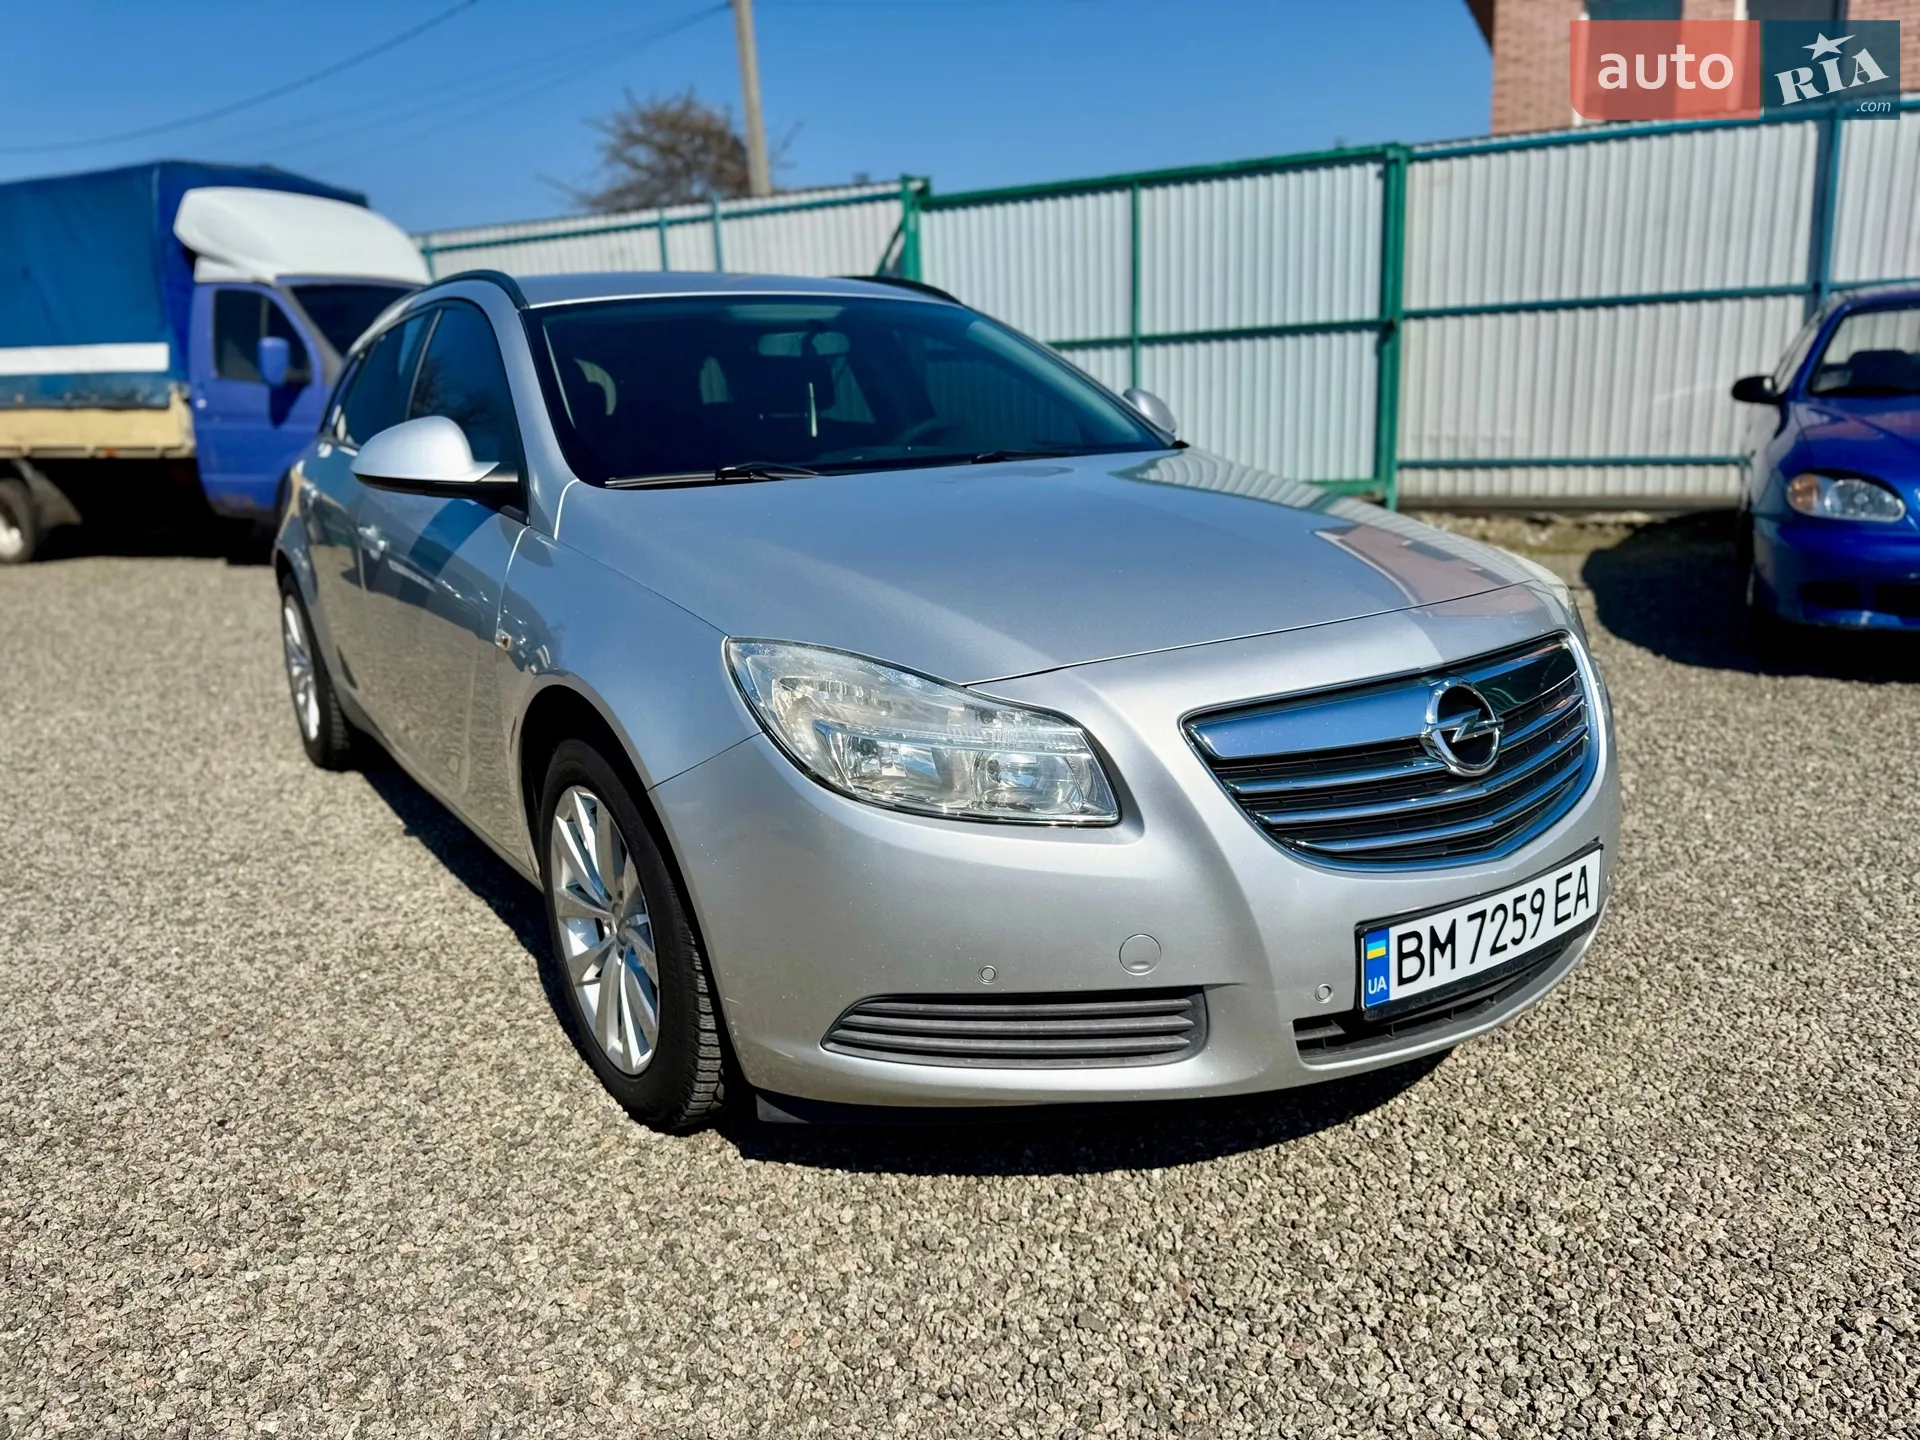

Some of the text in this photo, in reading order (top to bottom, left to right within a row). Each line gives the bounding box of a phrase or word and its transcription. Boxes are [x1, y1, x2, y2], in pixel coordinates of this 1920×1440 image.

[1397, 918, 1457, 987] BM
[1467, 888, 1546, 965] 7259
[1553, 864, 1590, 927] EA
[1368, 975, 1388, 995] UA
